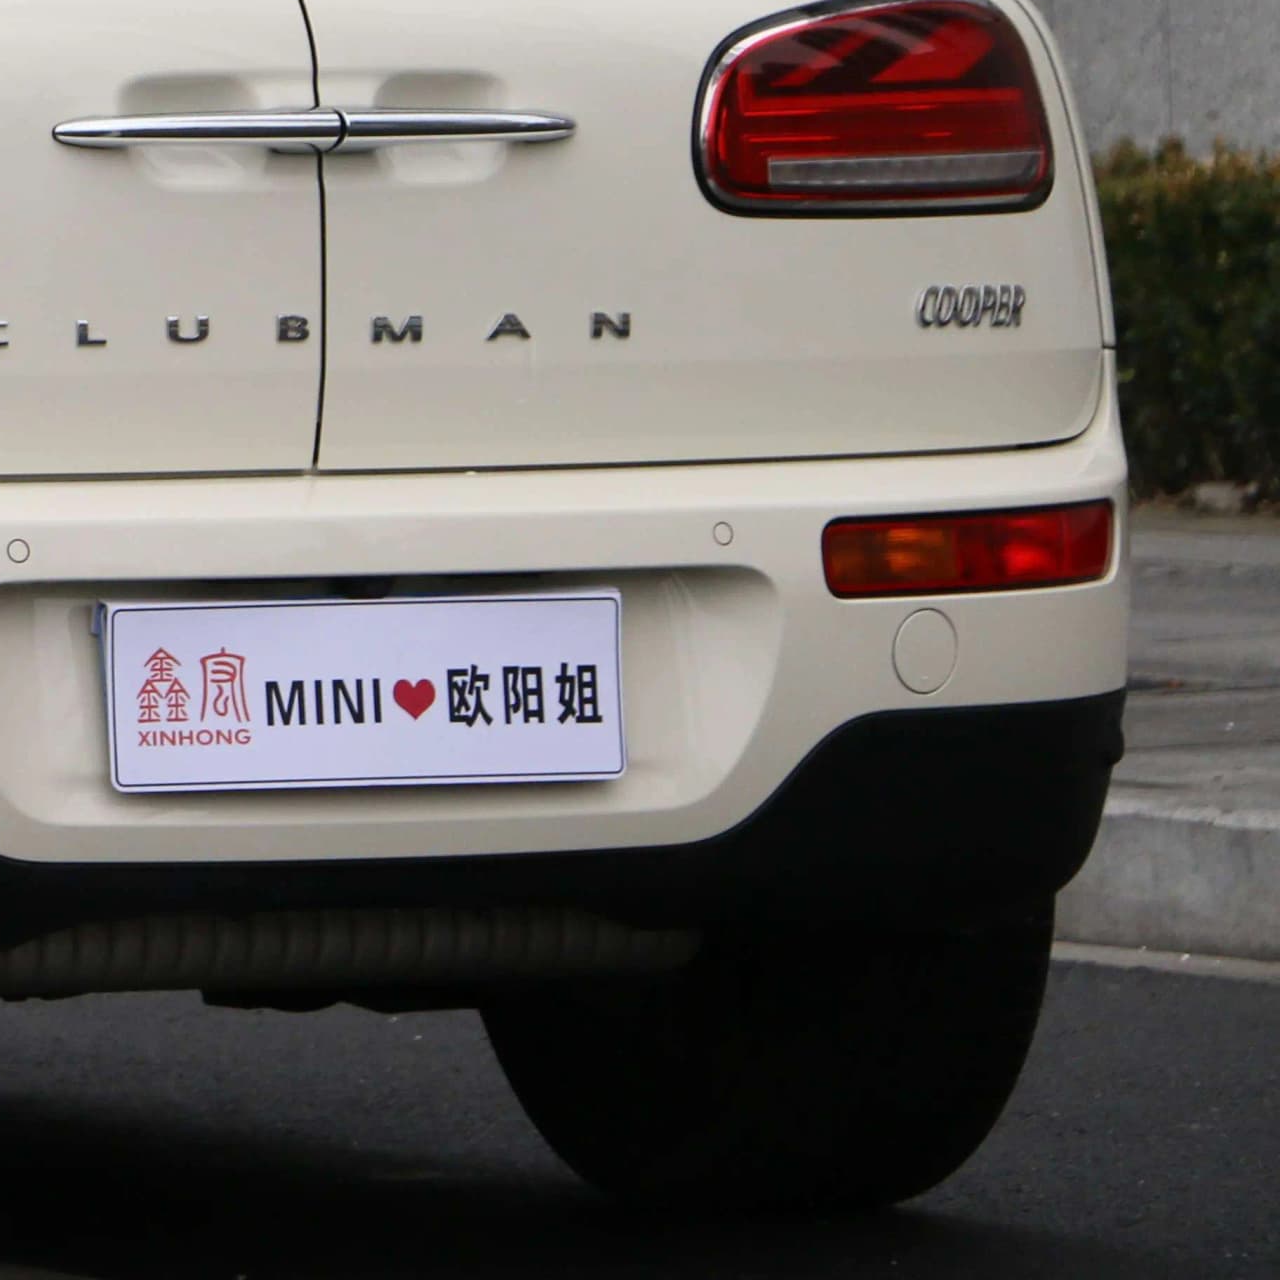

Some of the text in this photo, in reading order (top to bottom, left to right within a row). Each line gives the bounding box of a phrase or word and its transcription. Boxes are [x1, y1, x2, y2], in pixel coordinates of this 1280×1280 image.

[917, 284, 1026, 328] COOPER
[265, 662, 604, 728] MINI 欧阳姐
[138, 729, 251, 747] XINHONG
